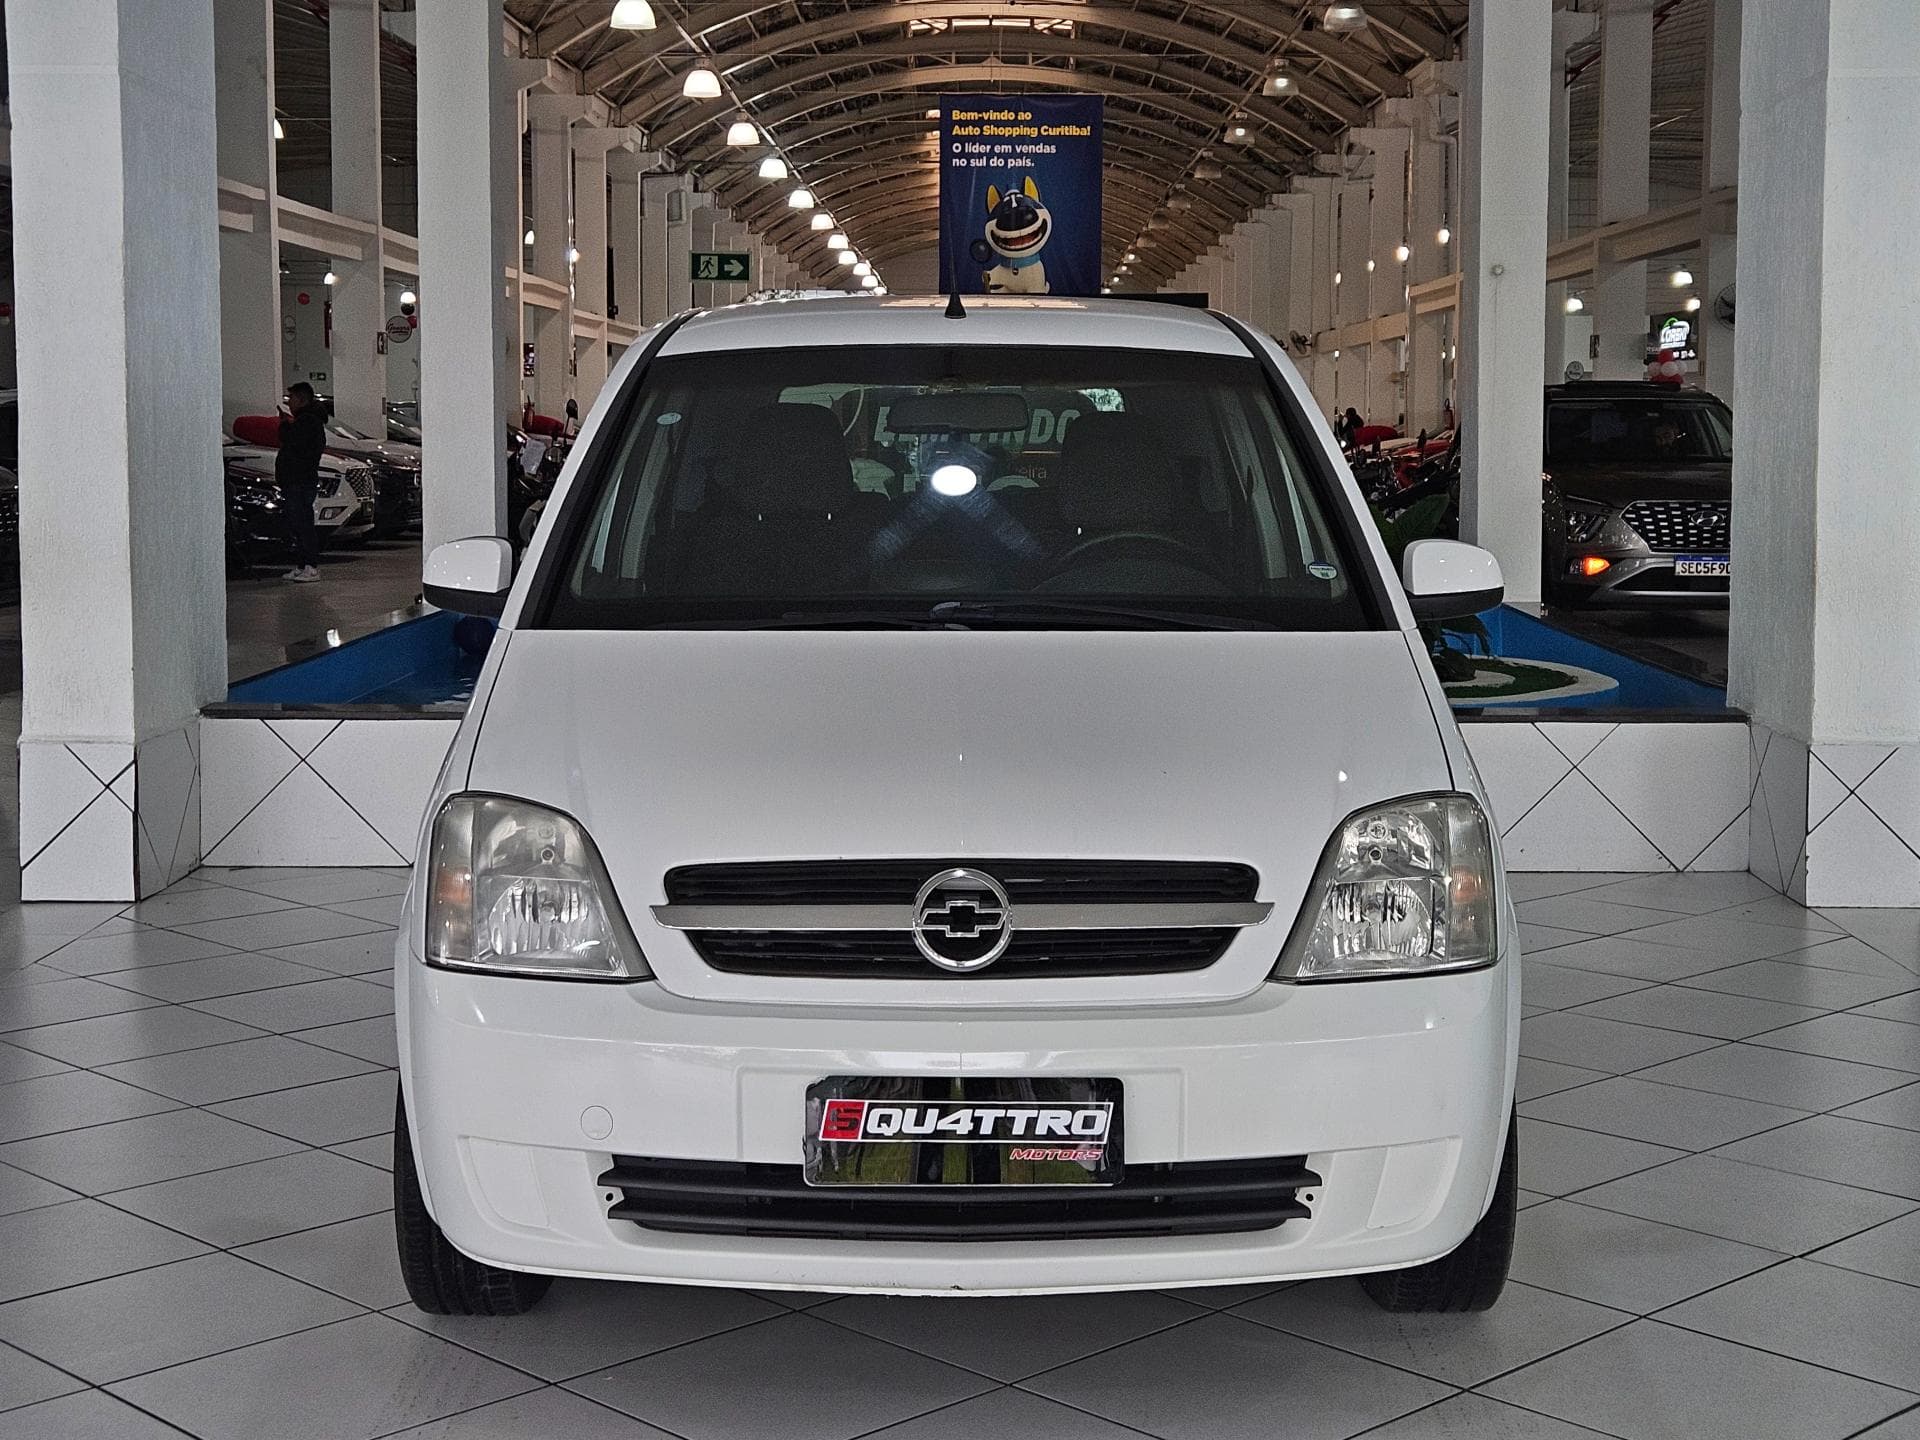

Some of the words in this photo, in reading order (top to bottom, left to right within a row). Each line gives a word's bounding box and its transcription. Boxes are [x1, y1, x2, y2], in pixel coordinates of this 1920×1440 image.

[952, 110, 1016, 120] Bem-vindo
[1017, 111, 1032, 120] ao
[952, 125, 981, 136] Auto
[982, 125, 1038, 137] Shopping
[1040, 125, 1091, 136] Curitiba!
[952, 143, 962, 153] O
[965, 142, 991, 153] líder
[994, 145, 1012, 153] em
[1015, 143, 1056, 153] vendas
[952, 158, 967, 167] no
[970, 156, 986, 167] sul
[989, 156, 1005, 167] do
[1007, 156, 1035, 169] país.
[1009, 1148, 1103, 1161] MOTORS
